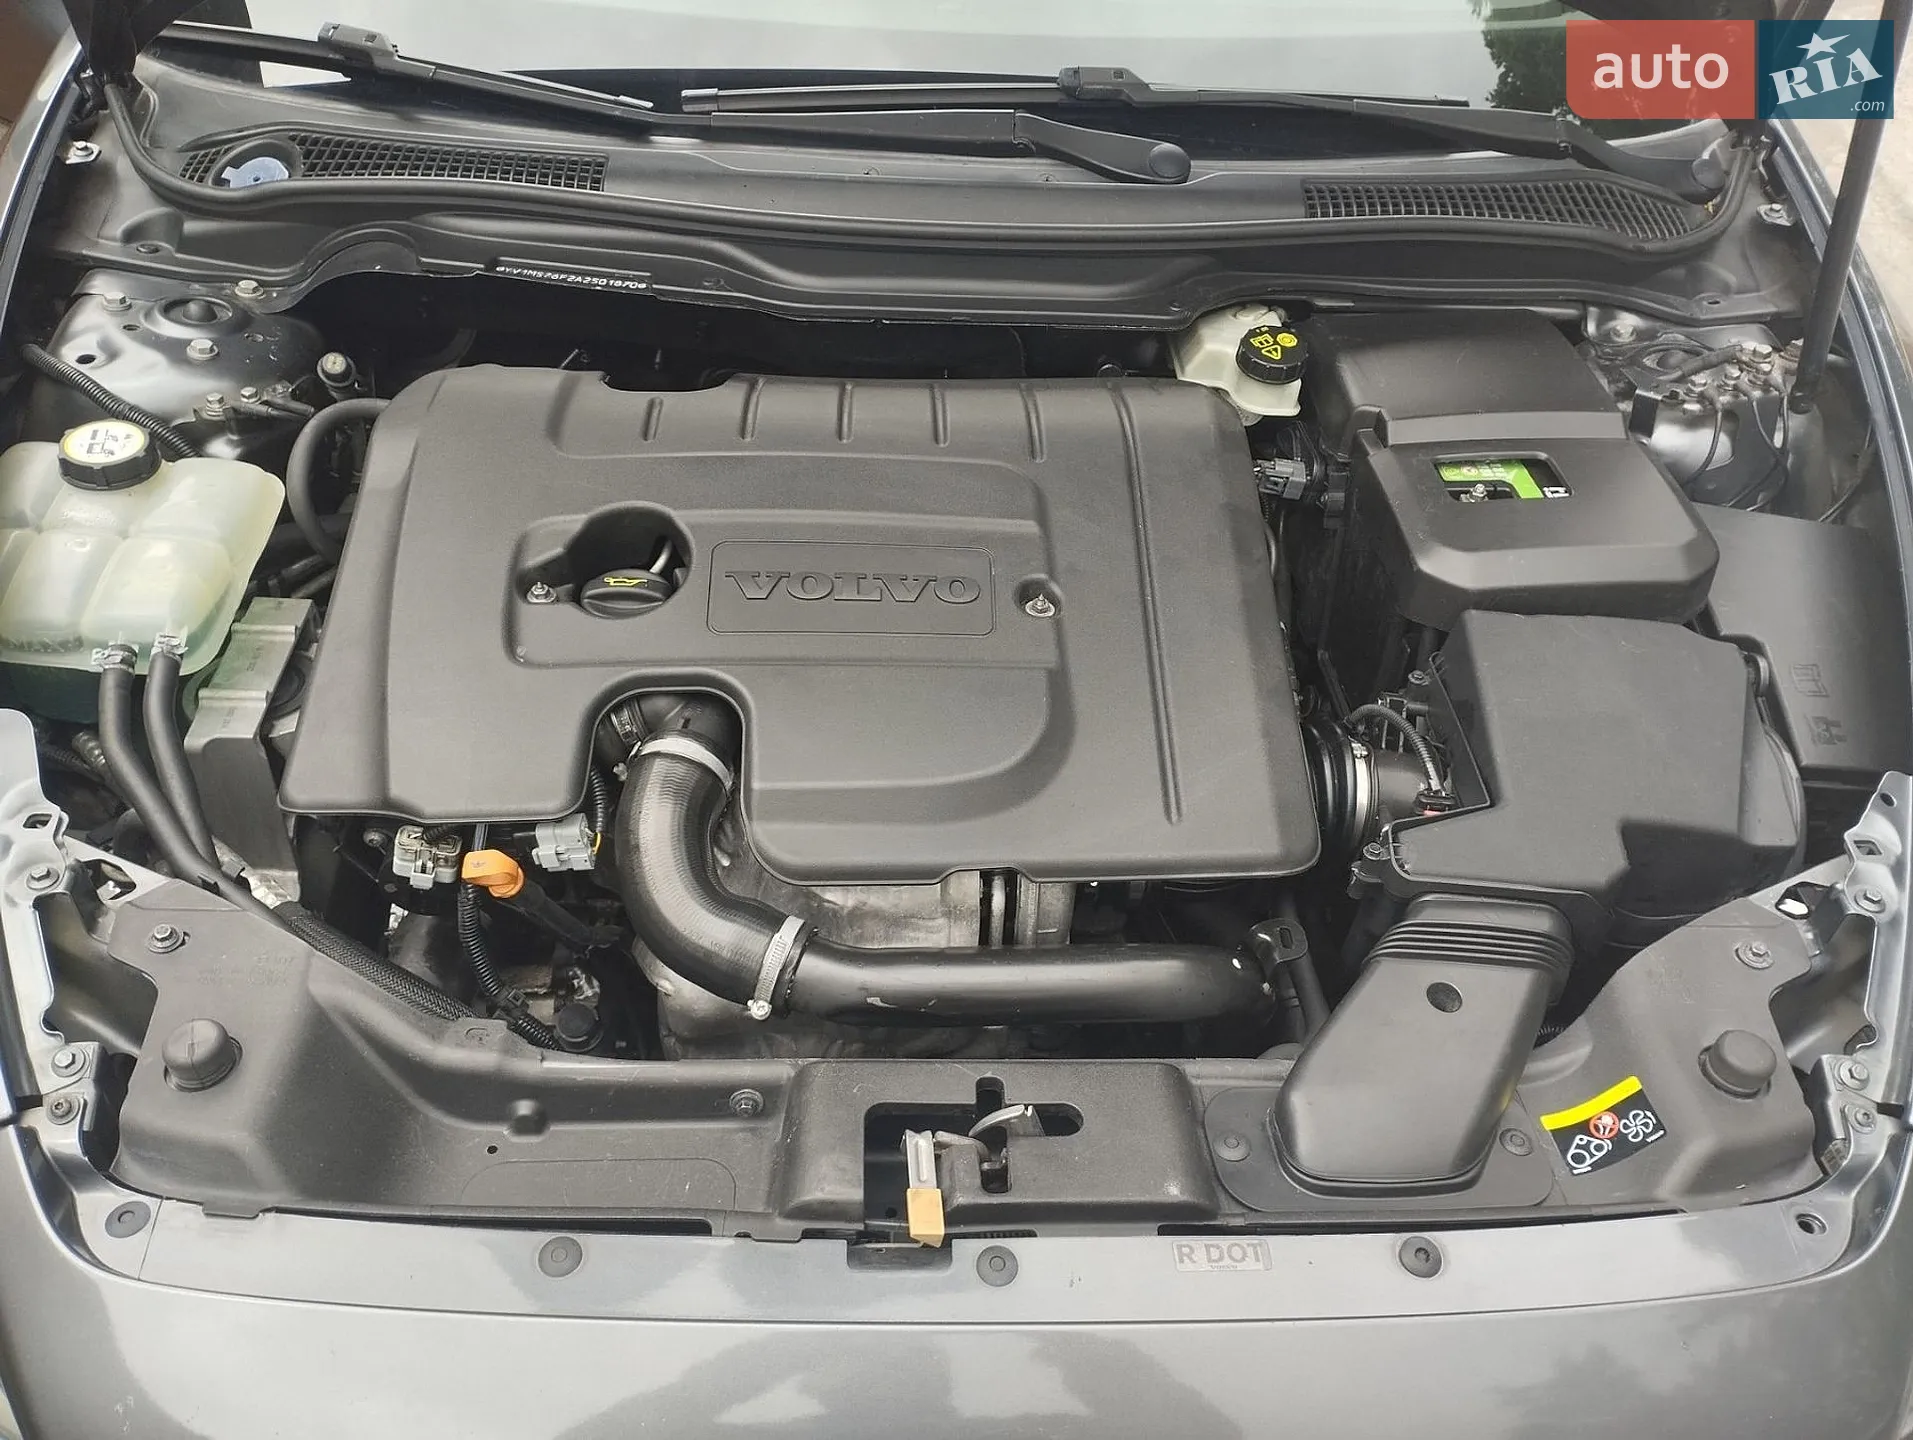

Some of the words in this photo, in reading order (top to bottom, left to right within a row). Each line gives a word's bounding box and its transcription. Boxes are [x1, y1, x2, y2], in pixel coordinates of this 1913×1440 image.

[725, 571, 981, 604] VOLVO
[1176, 1243, 1197, 1264] R
[1204, 1242, 1263, 1264] DOT
